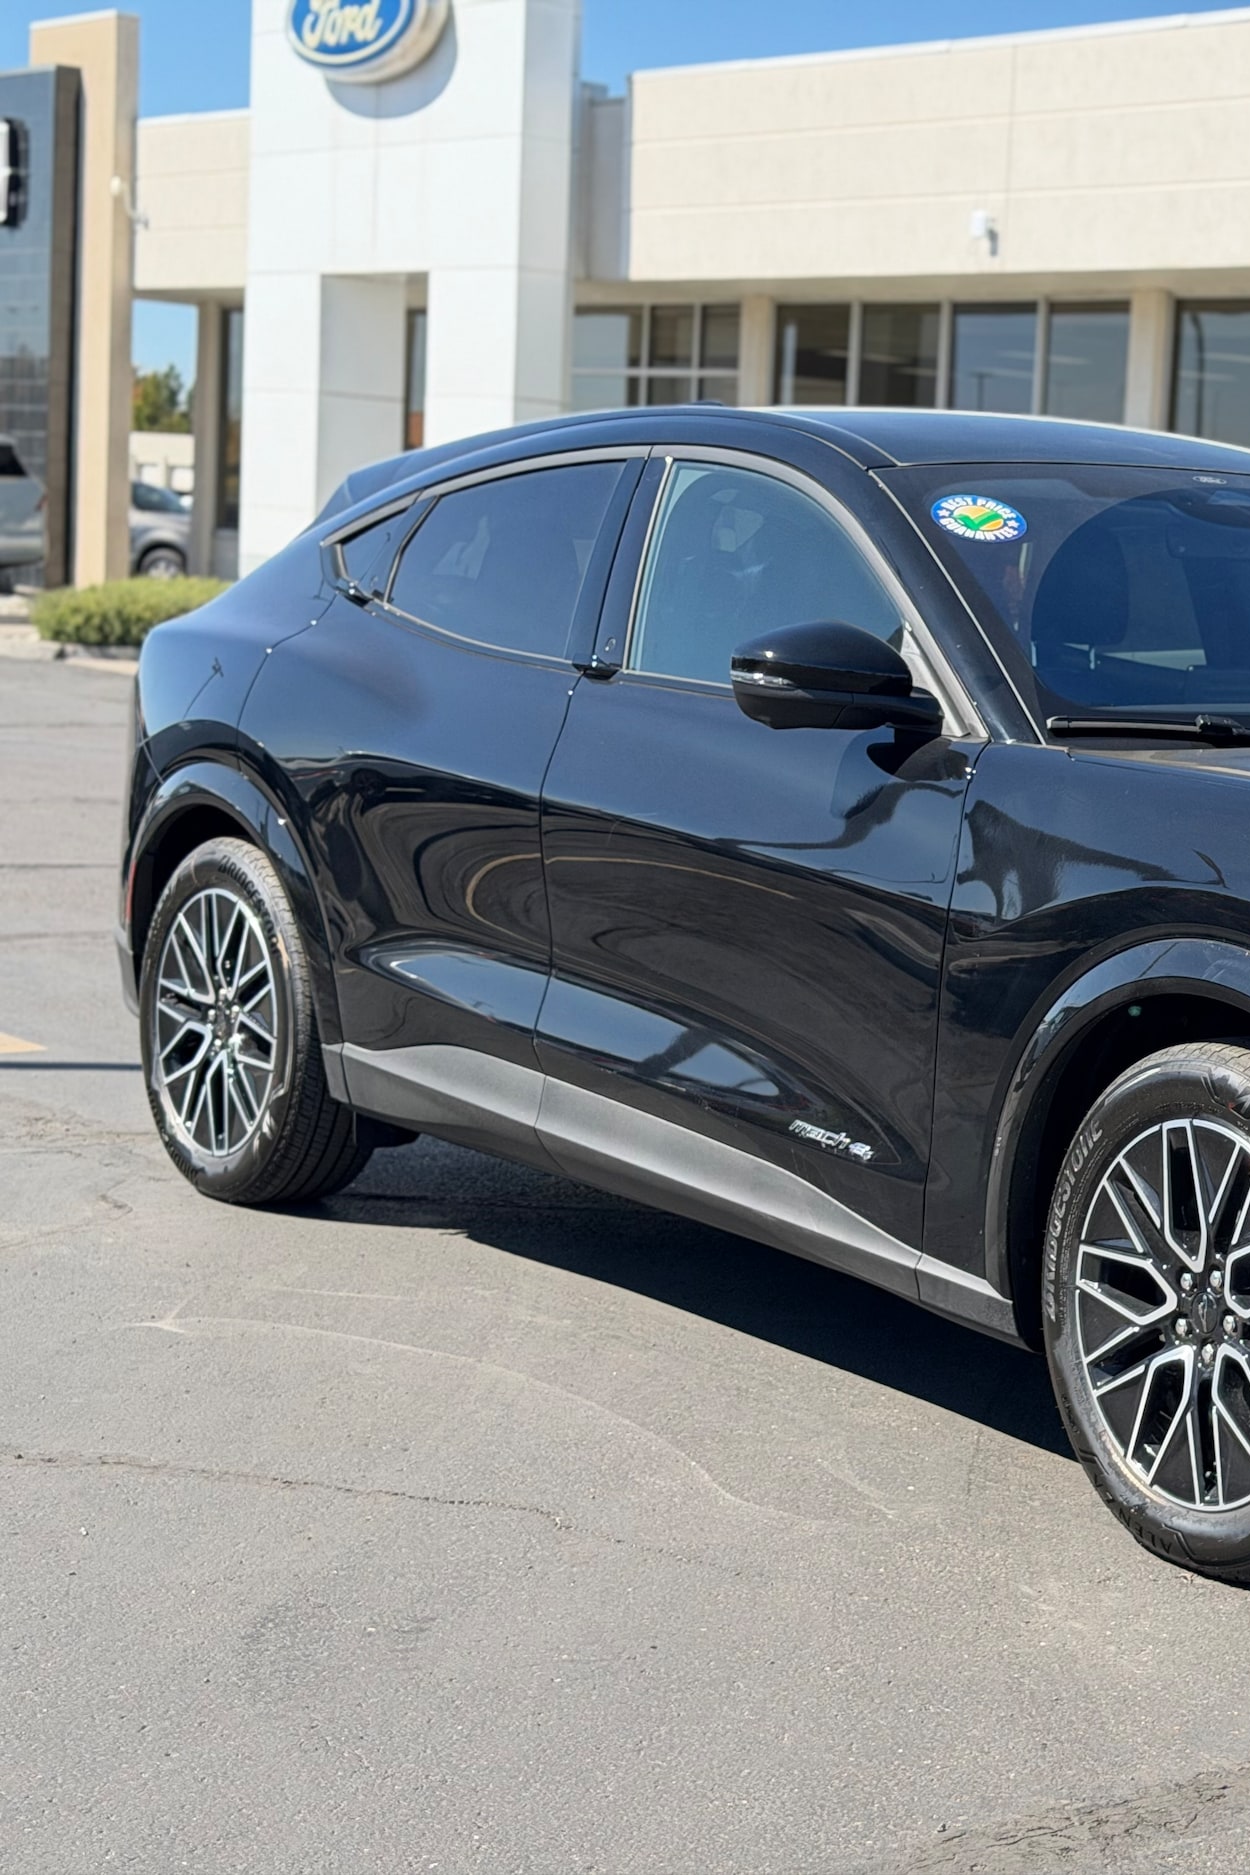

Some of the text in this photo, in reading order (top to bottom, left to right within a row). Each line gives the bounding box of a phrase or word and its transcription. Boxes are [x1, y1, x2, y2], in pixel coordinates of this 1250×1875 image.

[302, 0, 383, 50] Ford
[940, 497, 1017, 520] BEST PRICE
[939, 517, 1019, 541] GUARANTEE
